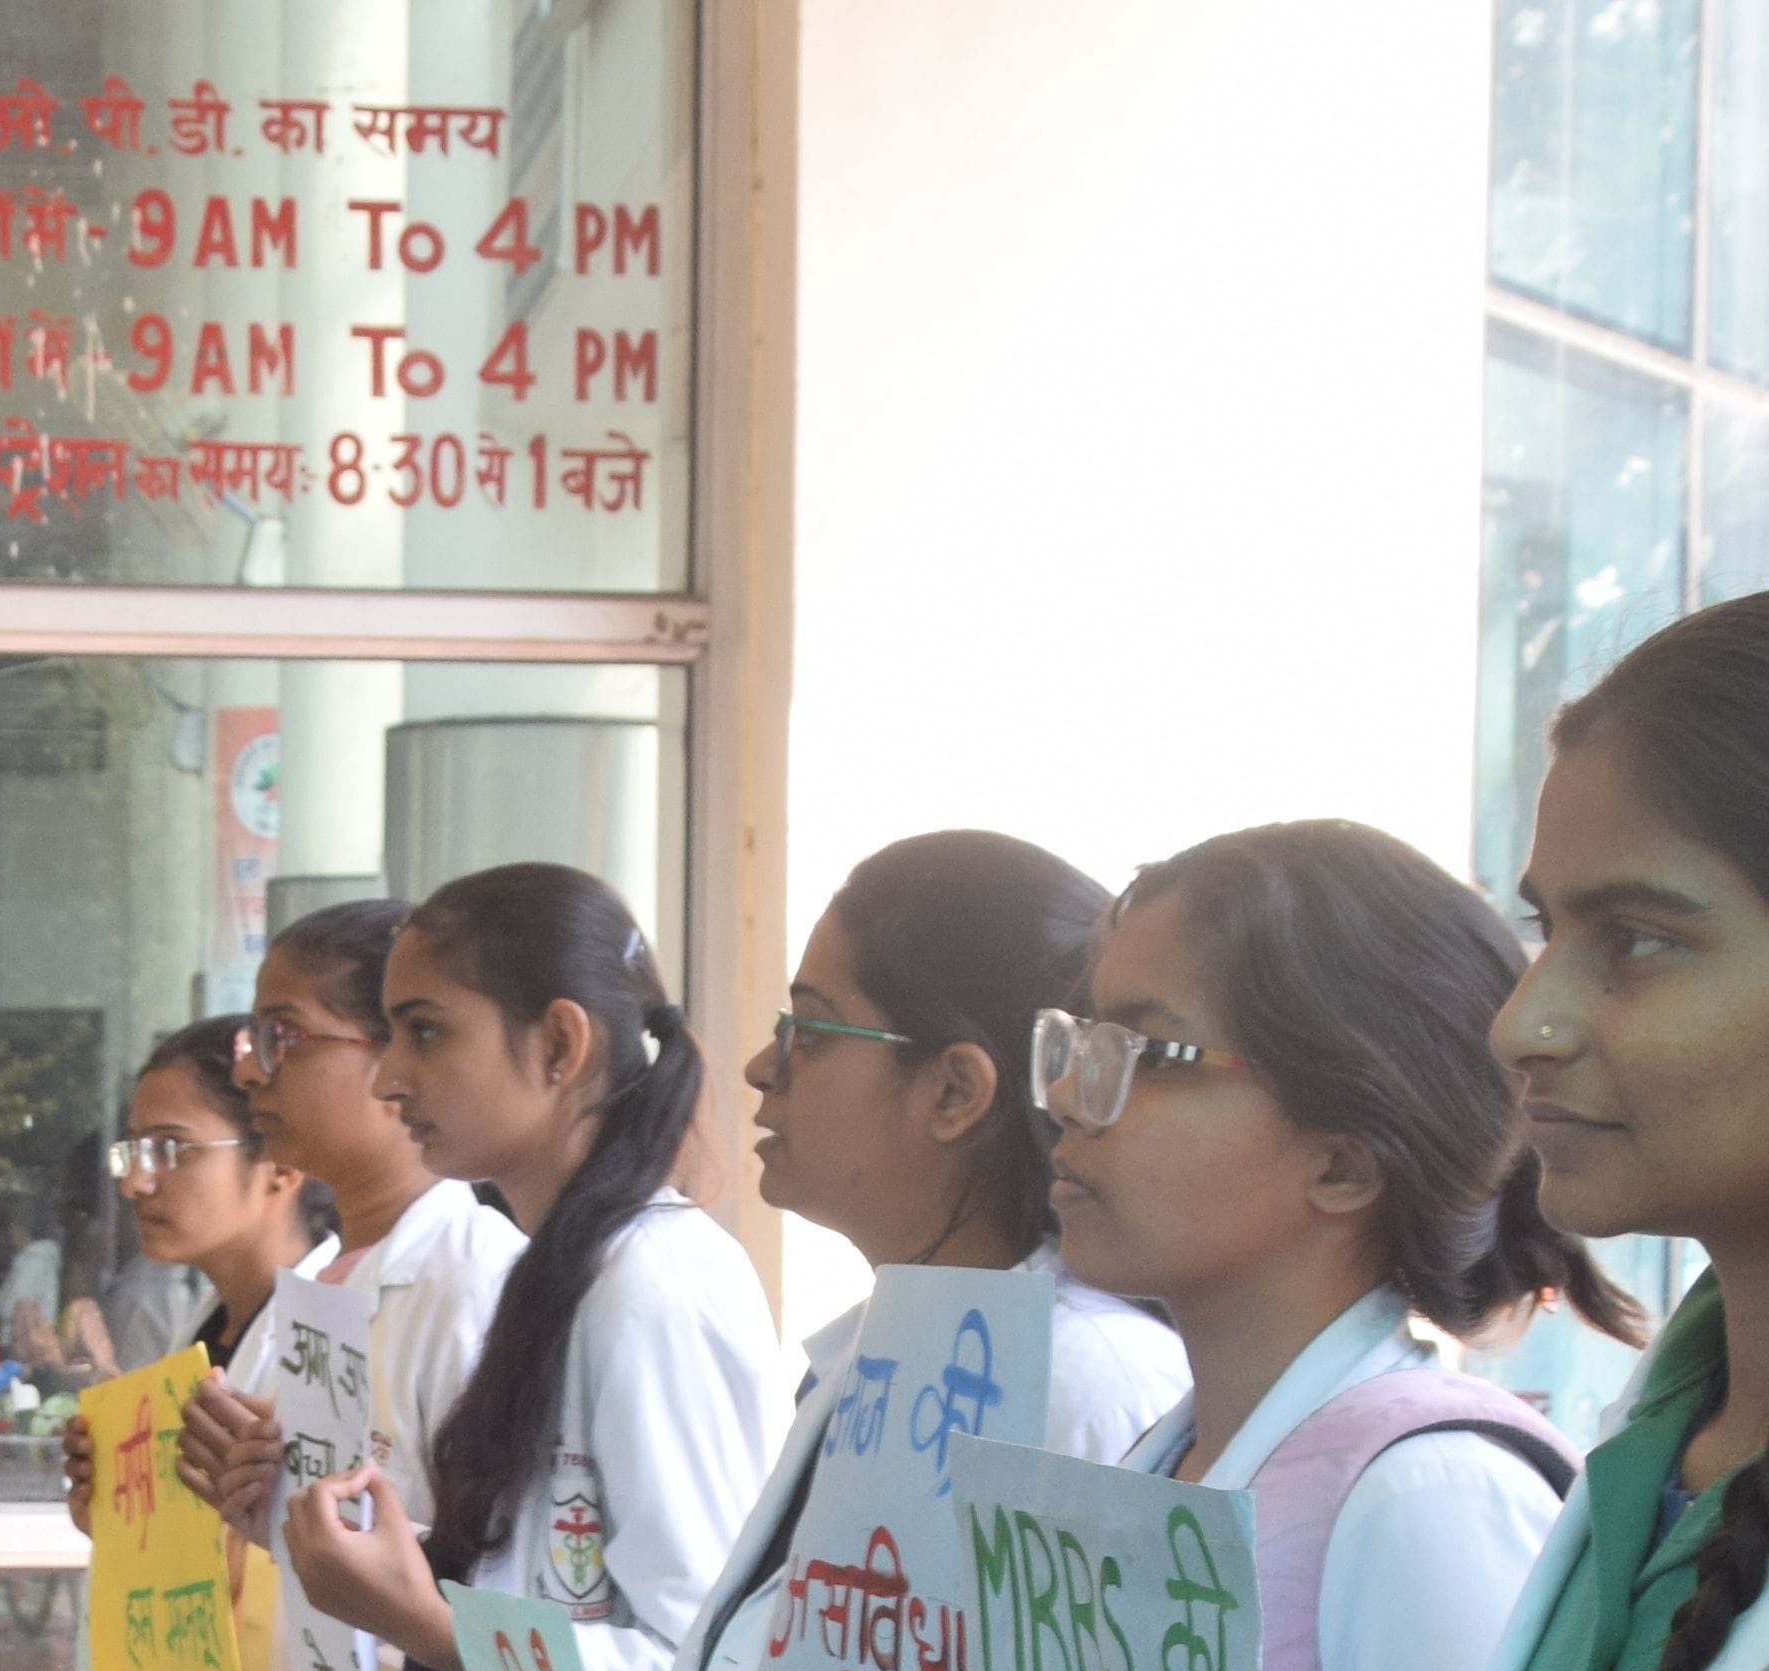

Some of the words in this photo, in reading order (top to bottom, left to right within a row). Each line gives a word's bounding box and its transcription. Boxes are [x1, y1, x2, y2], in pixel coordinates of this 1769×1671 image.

[259, 100, 329, 155] का
[352, 105, 507, 158] समय
[347, 199, 446, 274] To
[475, 196, 542, 274] 4
[574, 202, 661, 276] PM
[349, 325, 445, 399] To
[478, 320, 538, 402] 4
[574, 324, 659, 403] PM
[529, 433, 547, 511] 1
[560, 429, 652, 513] बजे
